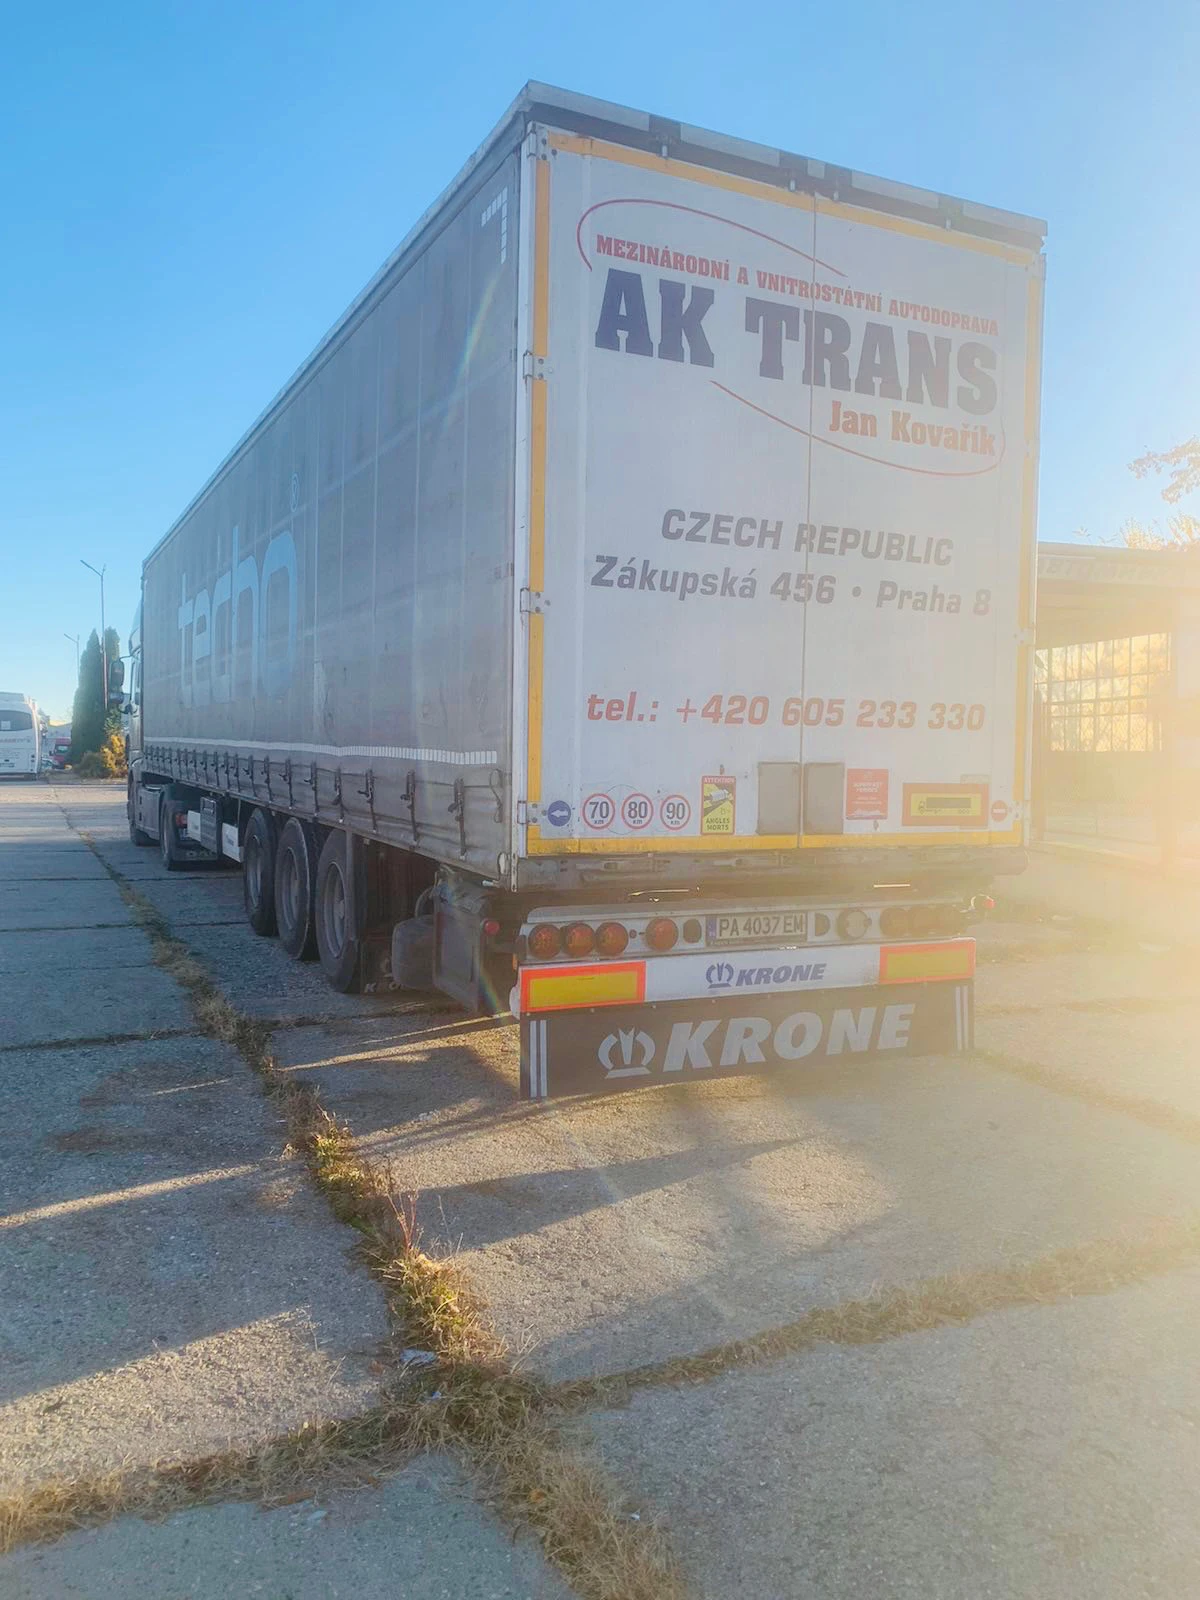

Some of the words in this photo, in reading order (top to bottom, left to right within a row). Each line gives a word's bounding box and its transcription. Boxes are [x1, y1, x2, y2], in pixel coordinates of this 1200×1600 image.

[596, 234, 730, 282] MEZINÁRODNÍ
[737, 266, 749, 285] A
[756, 271, 883, 313] VNITROSTÁTNÍ
[888, 299, 999, 337] AUTODOPRAVA
[595, 267, 715, 368] AK
[744, 296, 998, 416] TRANS
[829, 399, 878, 437] Jan
[891, 409, 996, 456] Kovařík
[661, 508, 784, 551] CZECH
[794, 523, 954, 566] REPUBLIC
[591, 554, 757, 601] Zákupská
[770, 571, 837, 604] 456
[876, 579, 962, 614] Praha
[972, 587, 992, 616] 8
[587, 691, 659, 722] tel.:
[675, 694, 770, 726] +420
[781, 697, 845, 727] 605
[856, 699, 917, 729] 233
[927, 702, 986, 731] 330
[589, 801, 609, 819] 70
[628, 801, 648, 819] 80
[666, 802, 686, 820] 90
[719, 918, 740, 937] PA
[743, 916, 780, 935] 4037
[783, 914, 804, 934] EM
[736, 963, 827, 987] KRONE
[663, 1003, 916, 1073] KRONE
